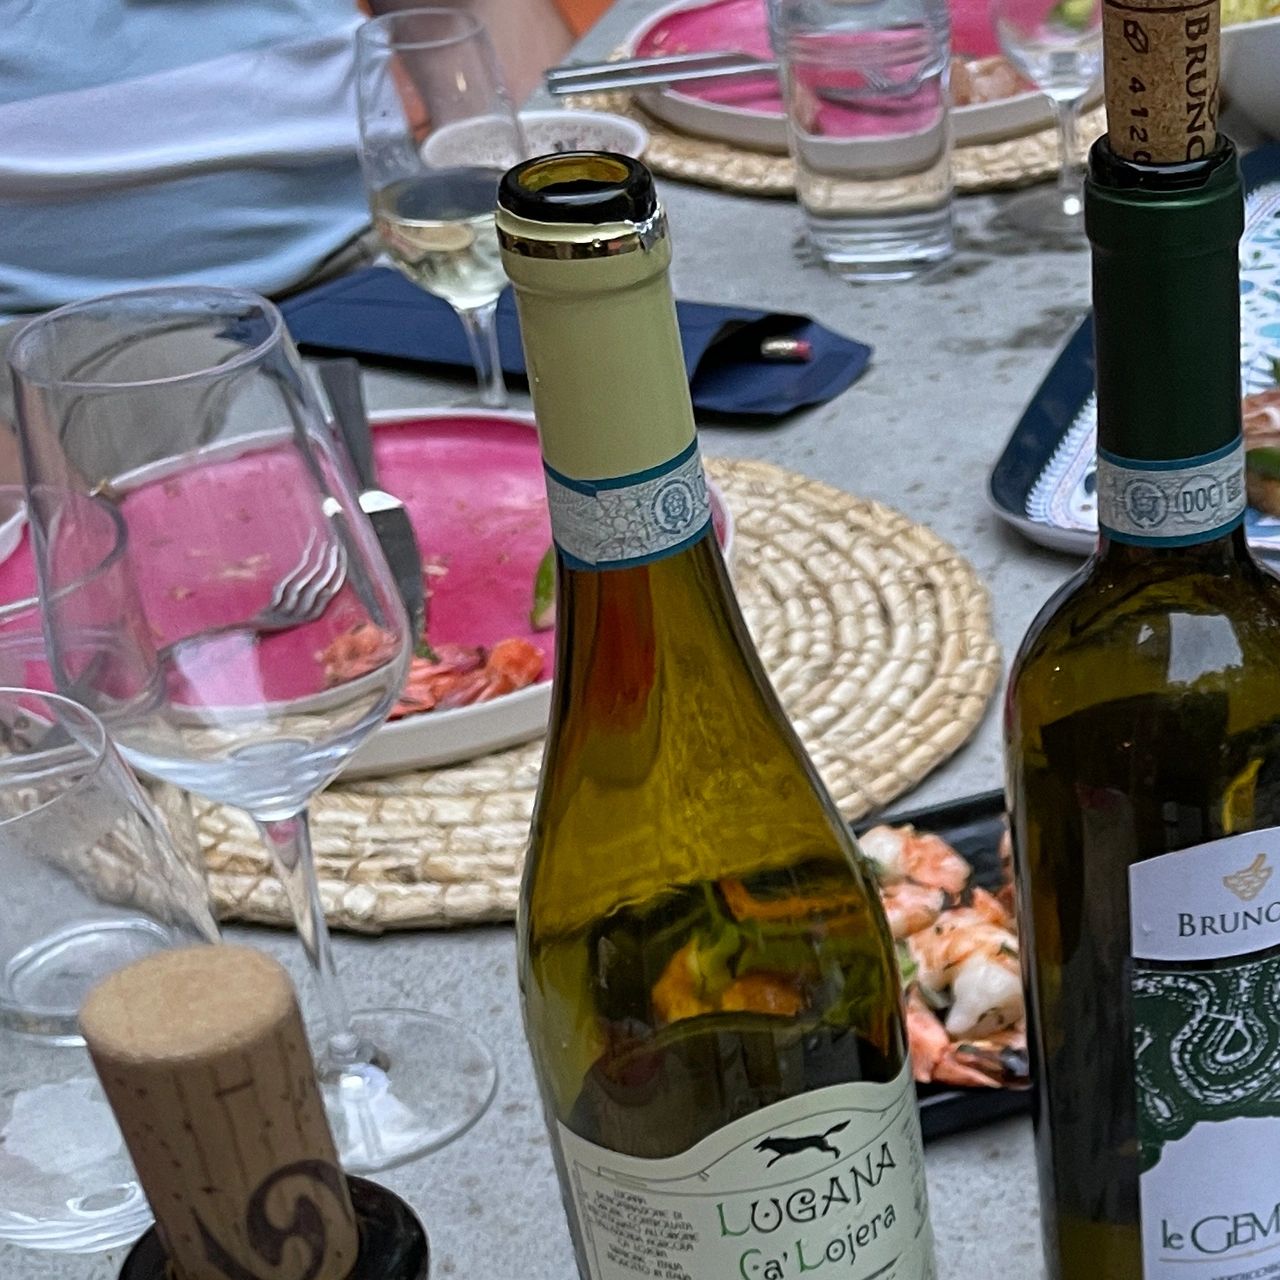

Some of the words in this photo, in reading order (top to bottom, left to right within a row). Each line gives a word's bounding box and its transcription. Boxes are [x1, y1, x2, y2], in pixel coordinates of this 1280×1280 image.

[1182, 484, 1216, 514] DOC
[716, 1142, 898, 1238] LUGANA
[797, 1202, 898, 1276] Lojera
[1161, 1218, 1185, 1250] le
